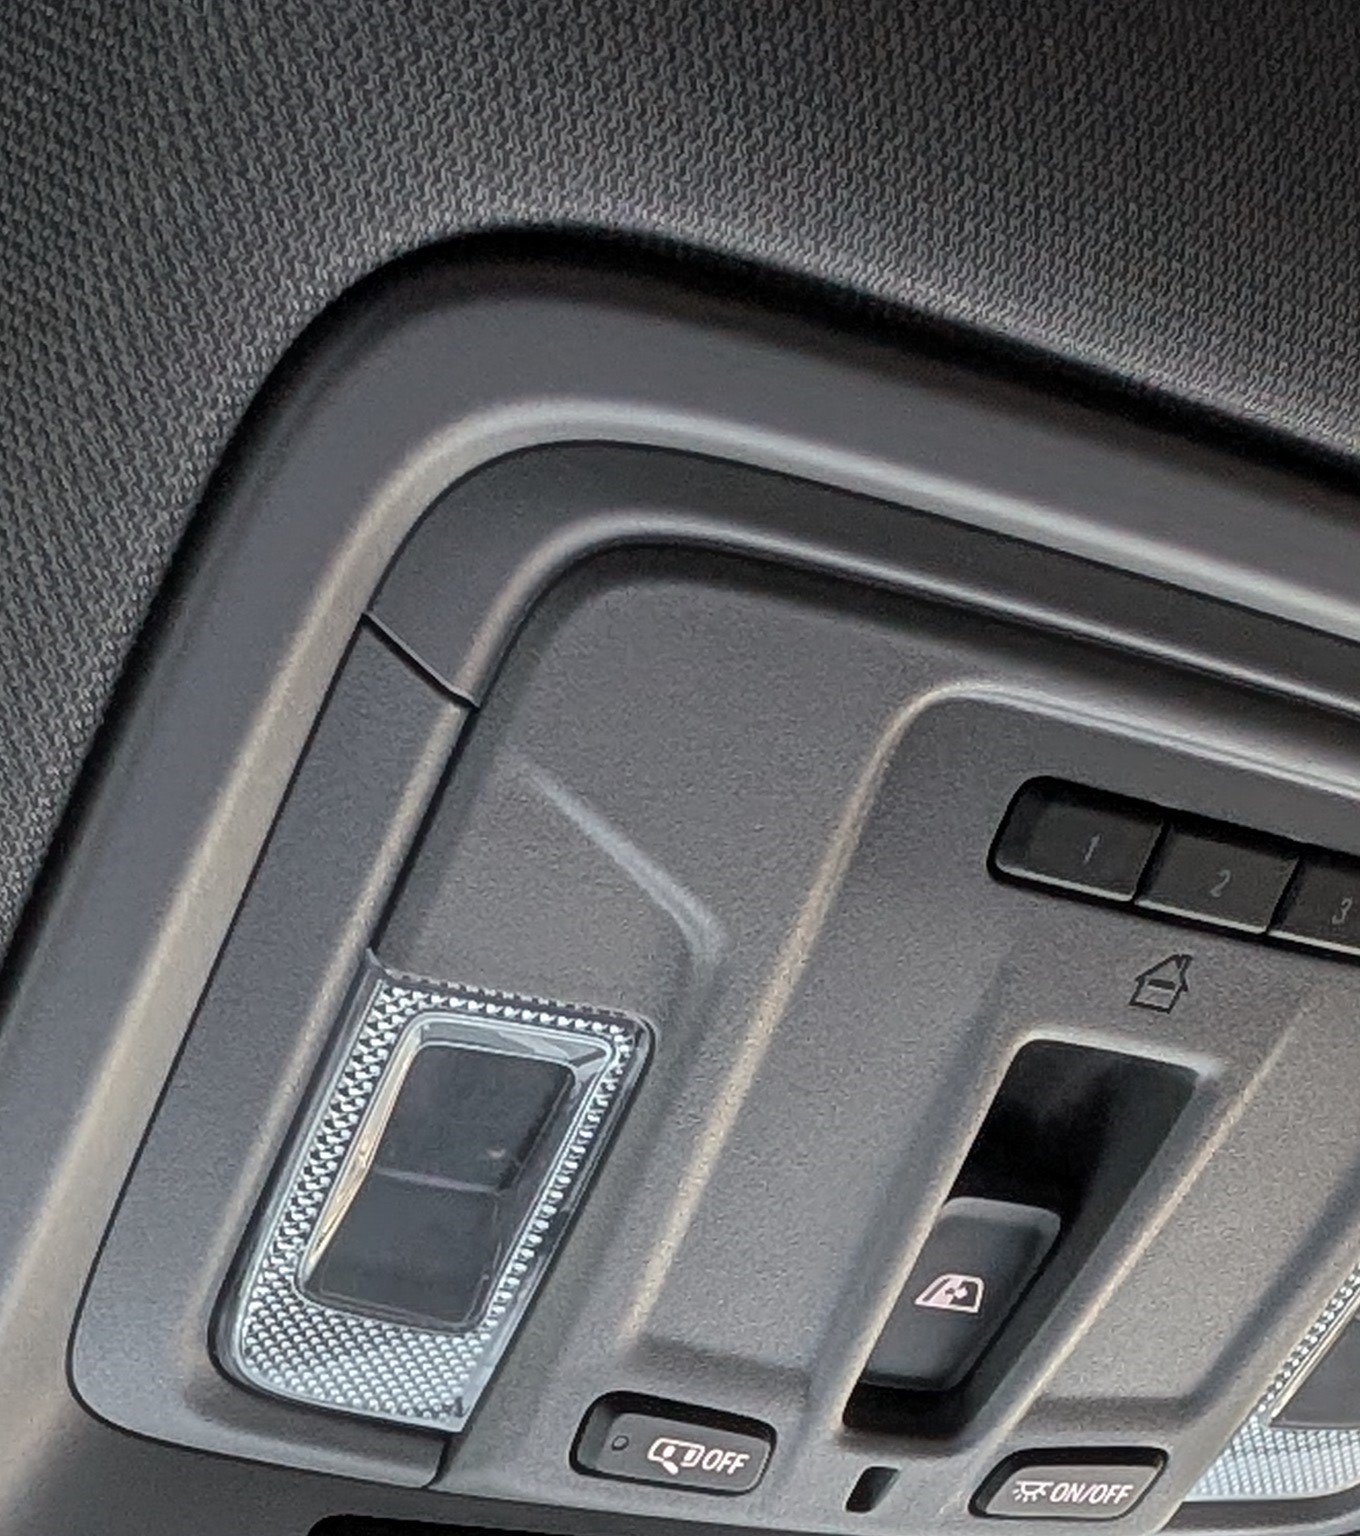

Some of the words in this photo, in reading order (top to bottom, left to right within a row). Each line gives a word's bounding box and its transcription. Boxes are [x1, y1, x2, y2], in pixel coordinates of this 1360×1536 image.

[1083, 835, 1100, 864] 1
[1210, 868, 1232, 897] 2
[1331, 898, 1353, 924] 3
[701, 1449, 750, 1475] OFF
[1049, 1482, 1133, 1505] ON/OFF
